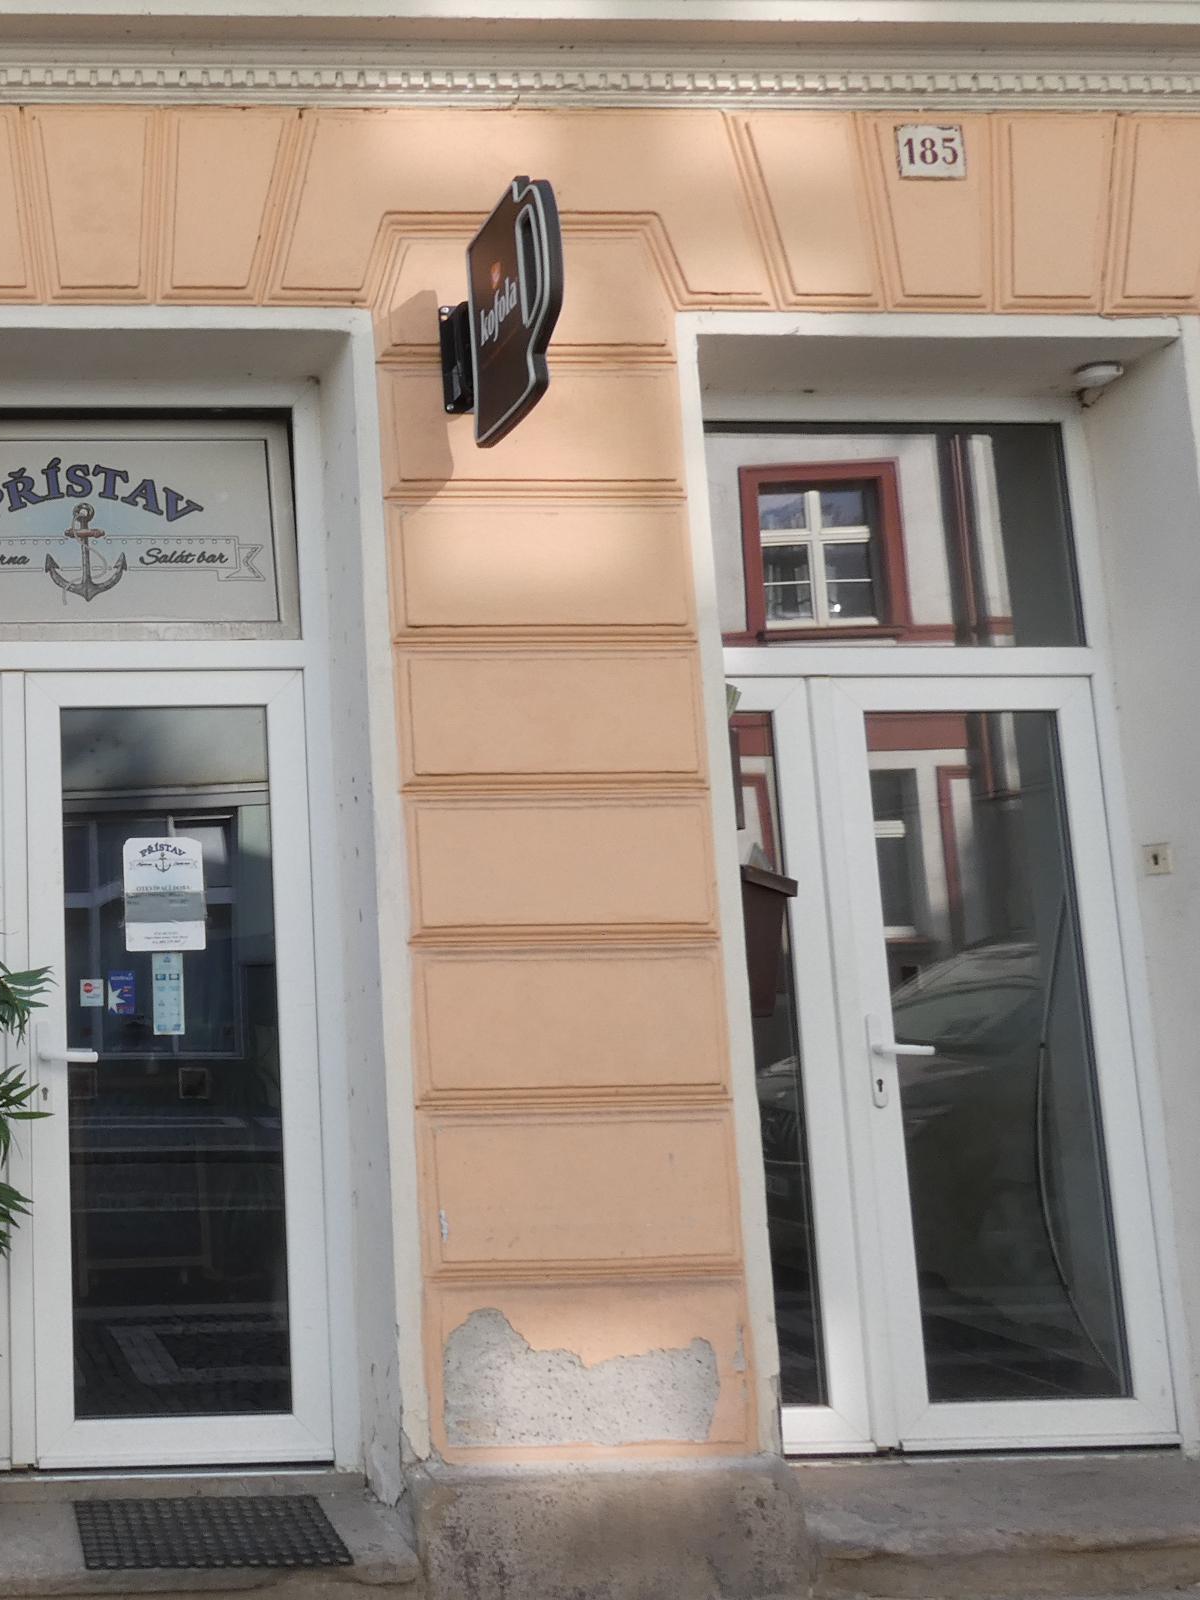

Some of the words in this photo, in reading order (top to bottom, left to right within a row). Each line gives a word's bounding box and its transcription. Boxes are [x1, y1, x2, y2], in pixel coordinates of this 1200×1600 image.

[903, 137, 959, 165] 185
[480, 277, 518, 347] kofola
[139, 548, 196, 566] Salát
[197, 550, 229, 564] bar
